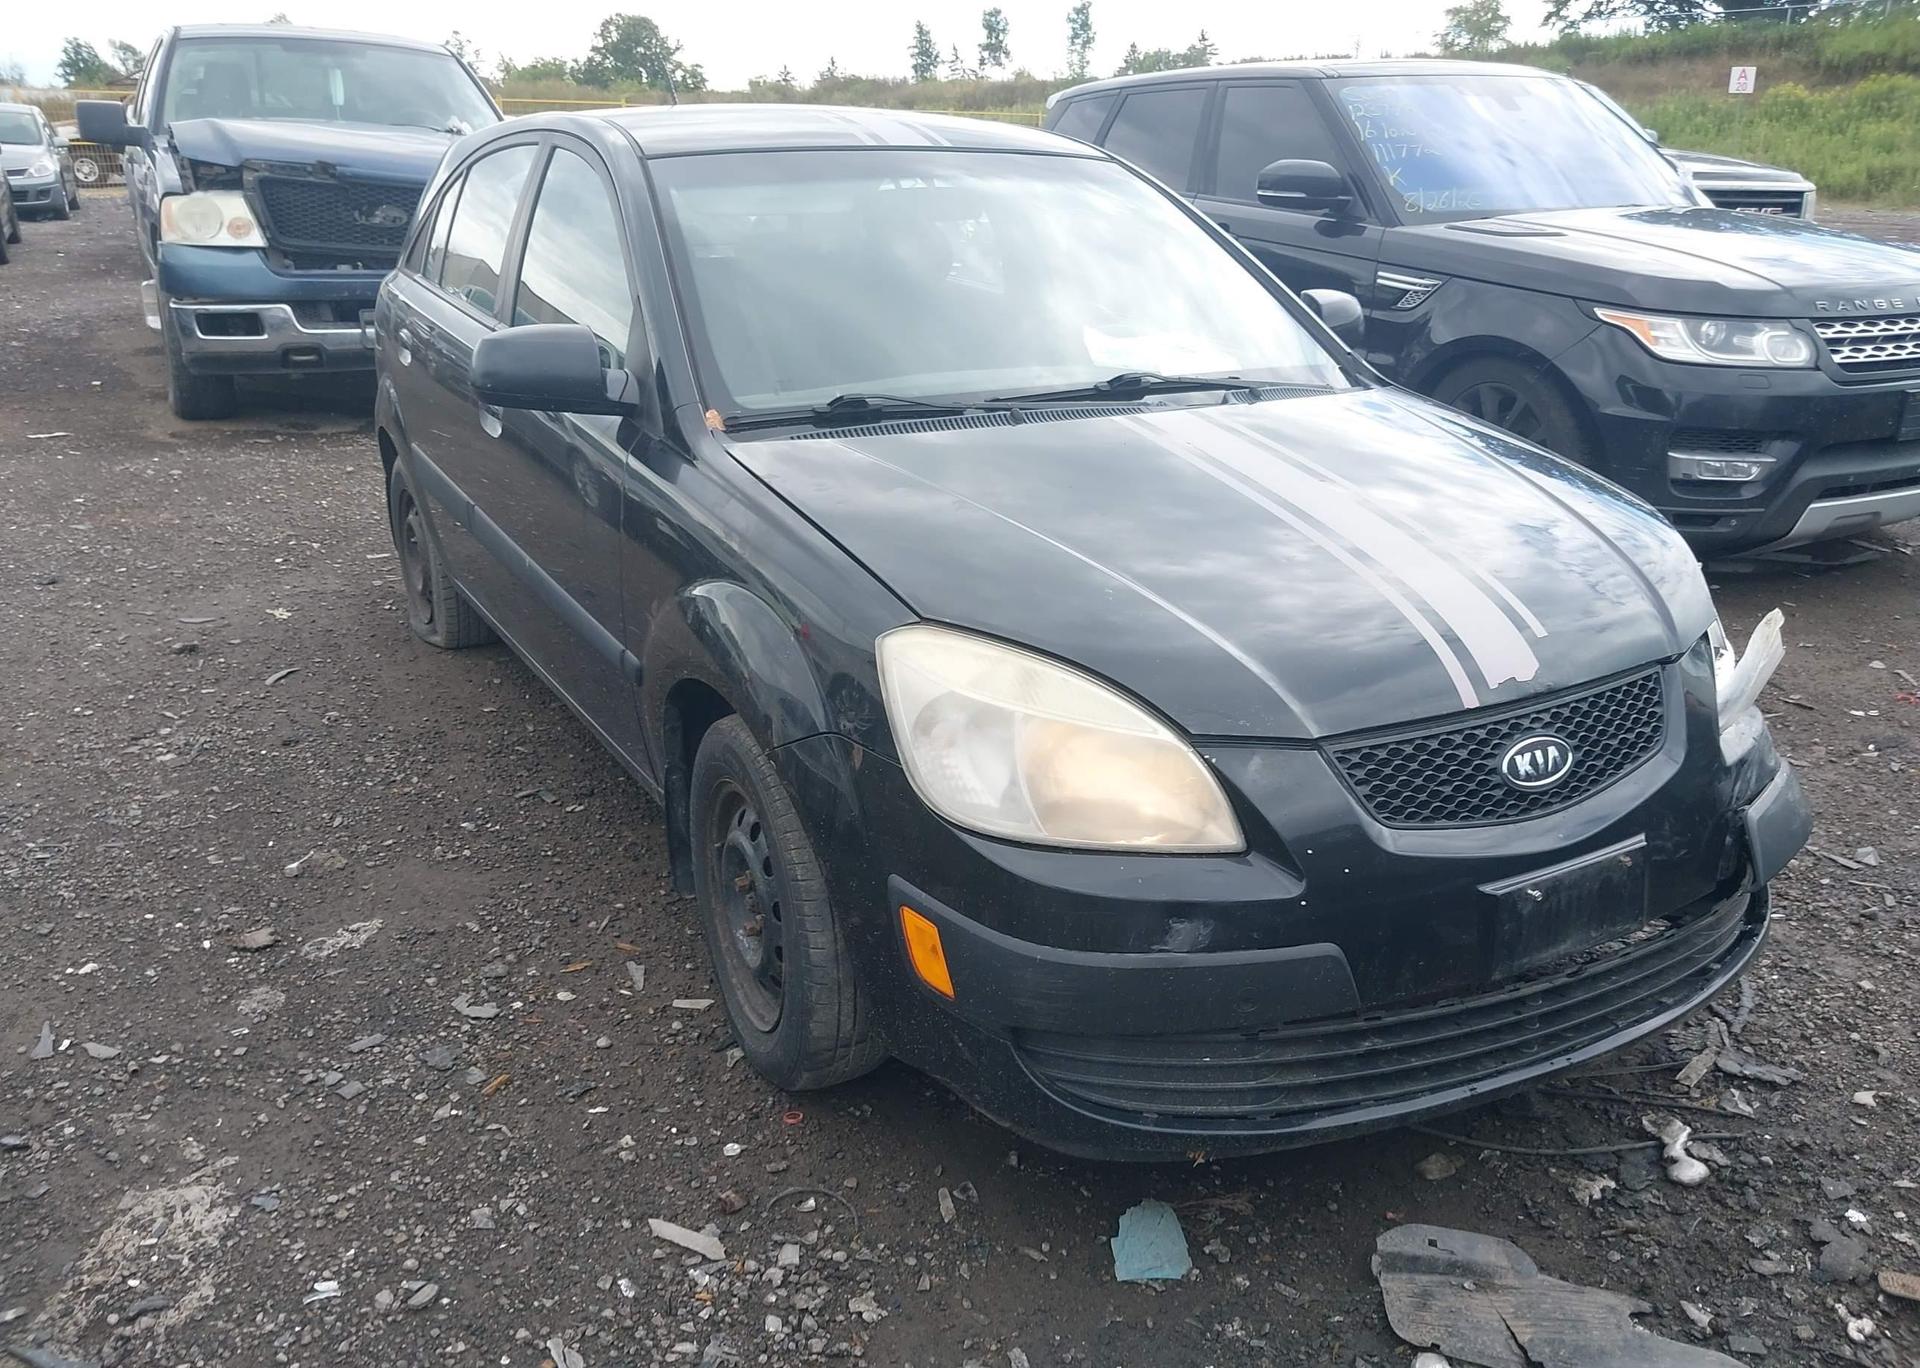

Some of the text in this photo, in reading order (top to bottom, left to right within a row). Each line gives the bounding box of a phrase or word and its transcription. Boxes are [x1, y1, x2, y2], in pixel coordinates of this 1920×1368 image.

[1738, 68, 1748, 81] A
[1815, 298, 1905, 311] RANGE
[1513, 745, 1564, 779] KIA
